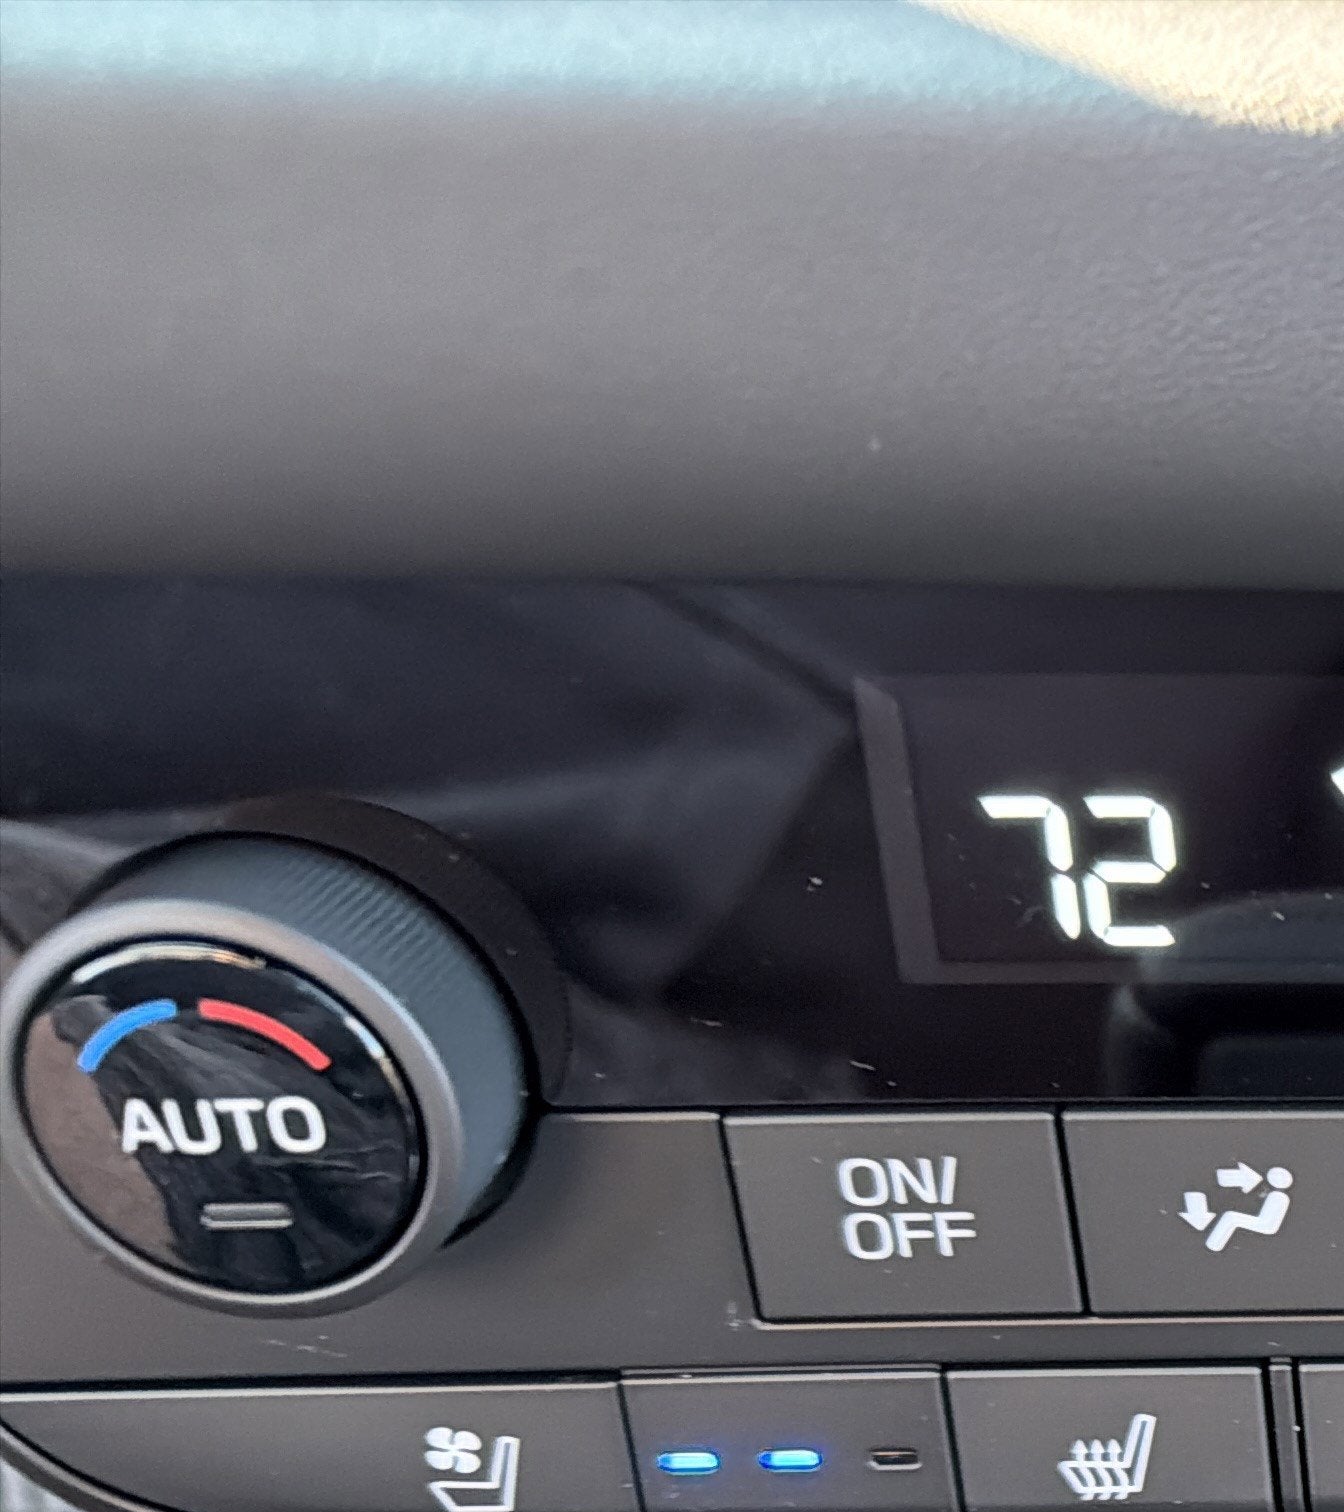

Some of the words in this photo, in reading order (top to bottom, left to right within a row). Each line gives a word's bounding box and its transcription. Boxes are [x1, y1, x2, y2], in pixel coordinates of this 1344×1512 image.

[977, 793, 1179, 949] 72
[120, 1094, 327, 1156] AUTO
[837, 1155, 958, 1208] ON/
[841, 1210, 978, 1261] OFF
